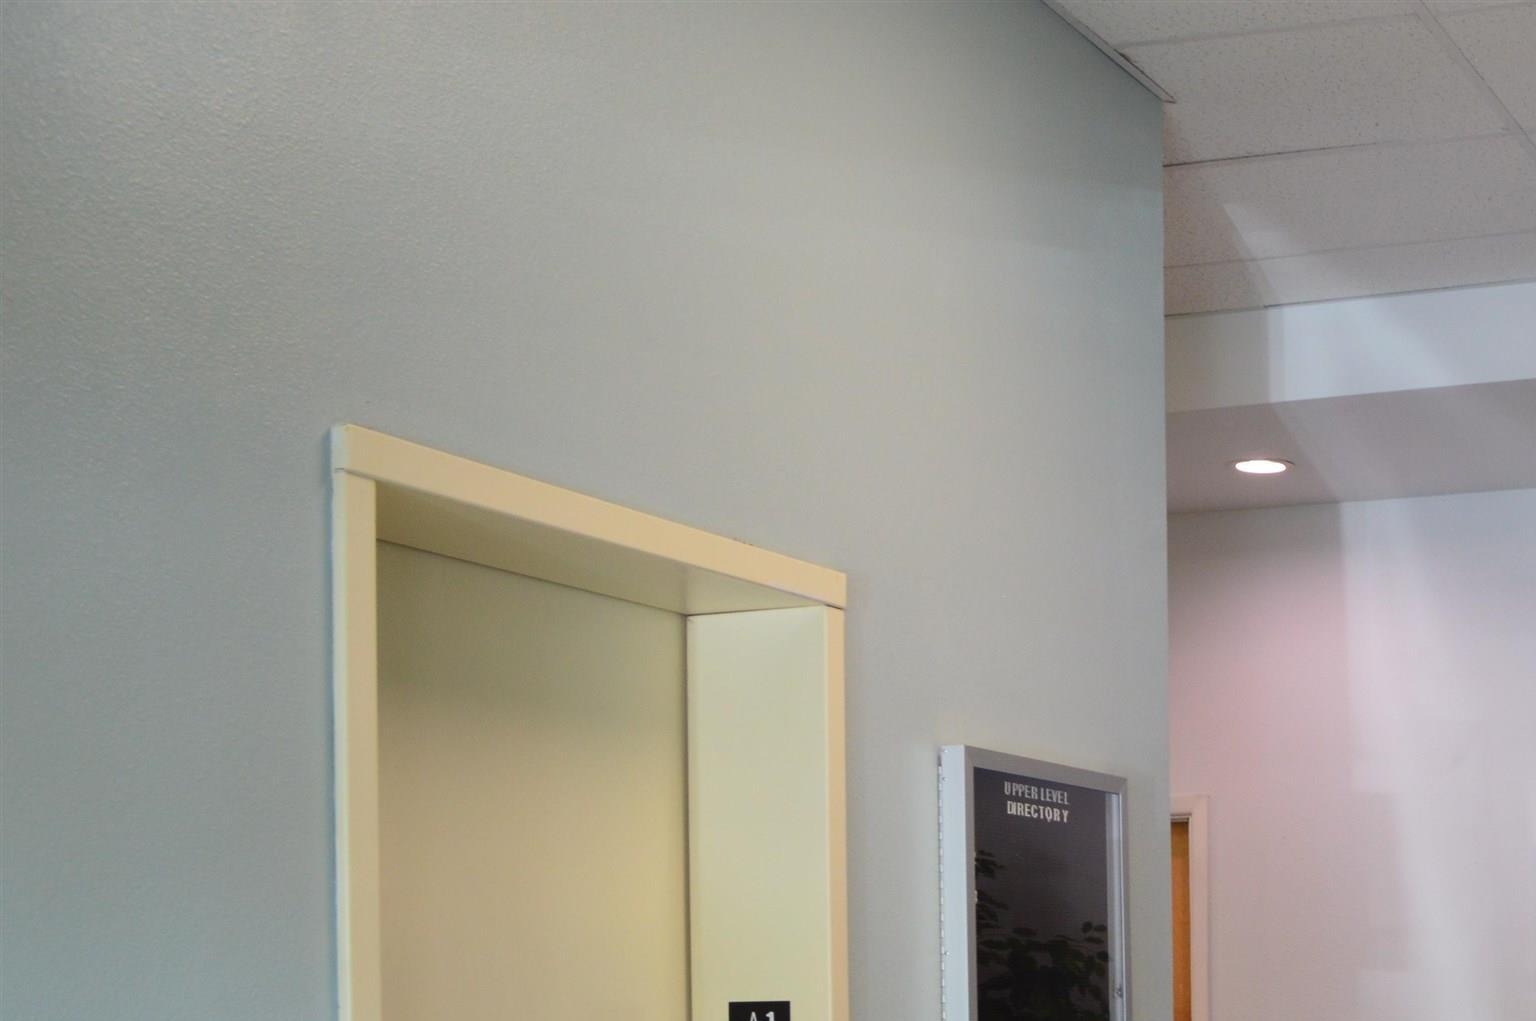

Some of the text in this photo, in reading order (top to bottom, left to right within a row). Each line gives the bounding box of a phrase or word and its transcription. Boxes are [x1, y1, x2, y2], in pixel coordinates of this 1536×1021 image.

[1004, 781, 1070, 805] UPPER LEVEL
[1006, 801, 1069, 823] DIRECTORY
